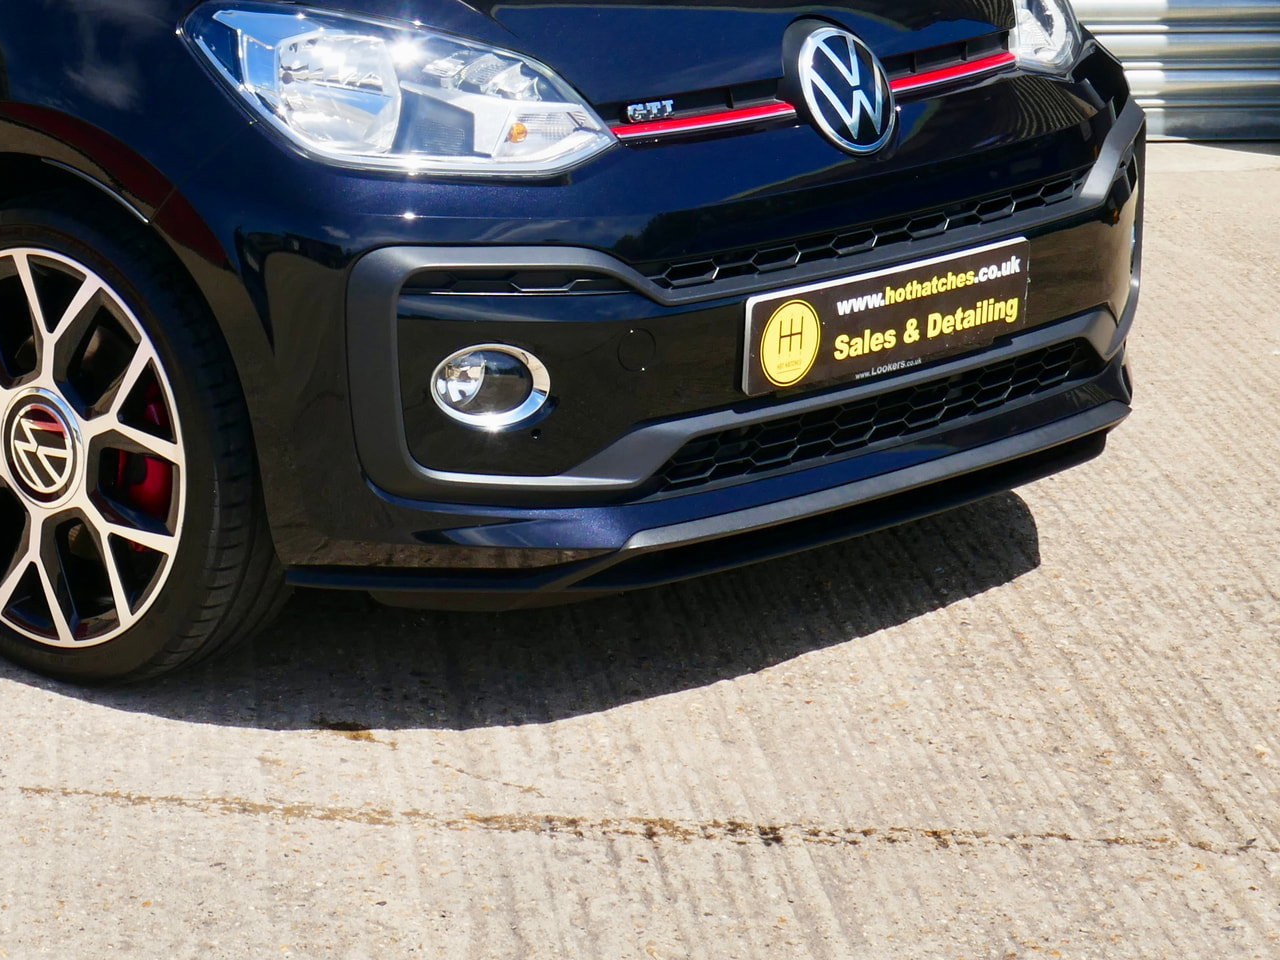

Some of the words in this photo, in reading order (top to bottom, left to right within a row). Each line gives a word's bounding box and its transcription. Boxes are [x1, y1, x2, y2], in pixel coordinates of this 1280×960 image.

[627, 99, 674, 122] GTI
[803, 30, 891, 150] VW
[836, 255, 1021, 316] www.hothatches.co.uk
[833, 329, 897, 361] Sales
[903, 317, 920, 344] &
[926, 296, 1019, 339] Detailing
